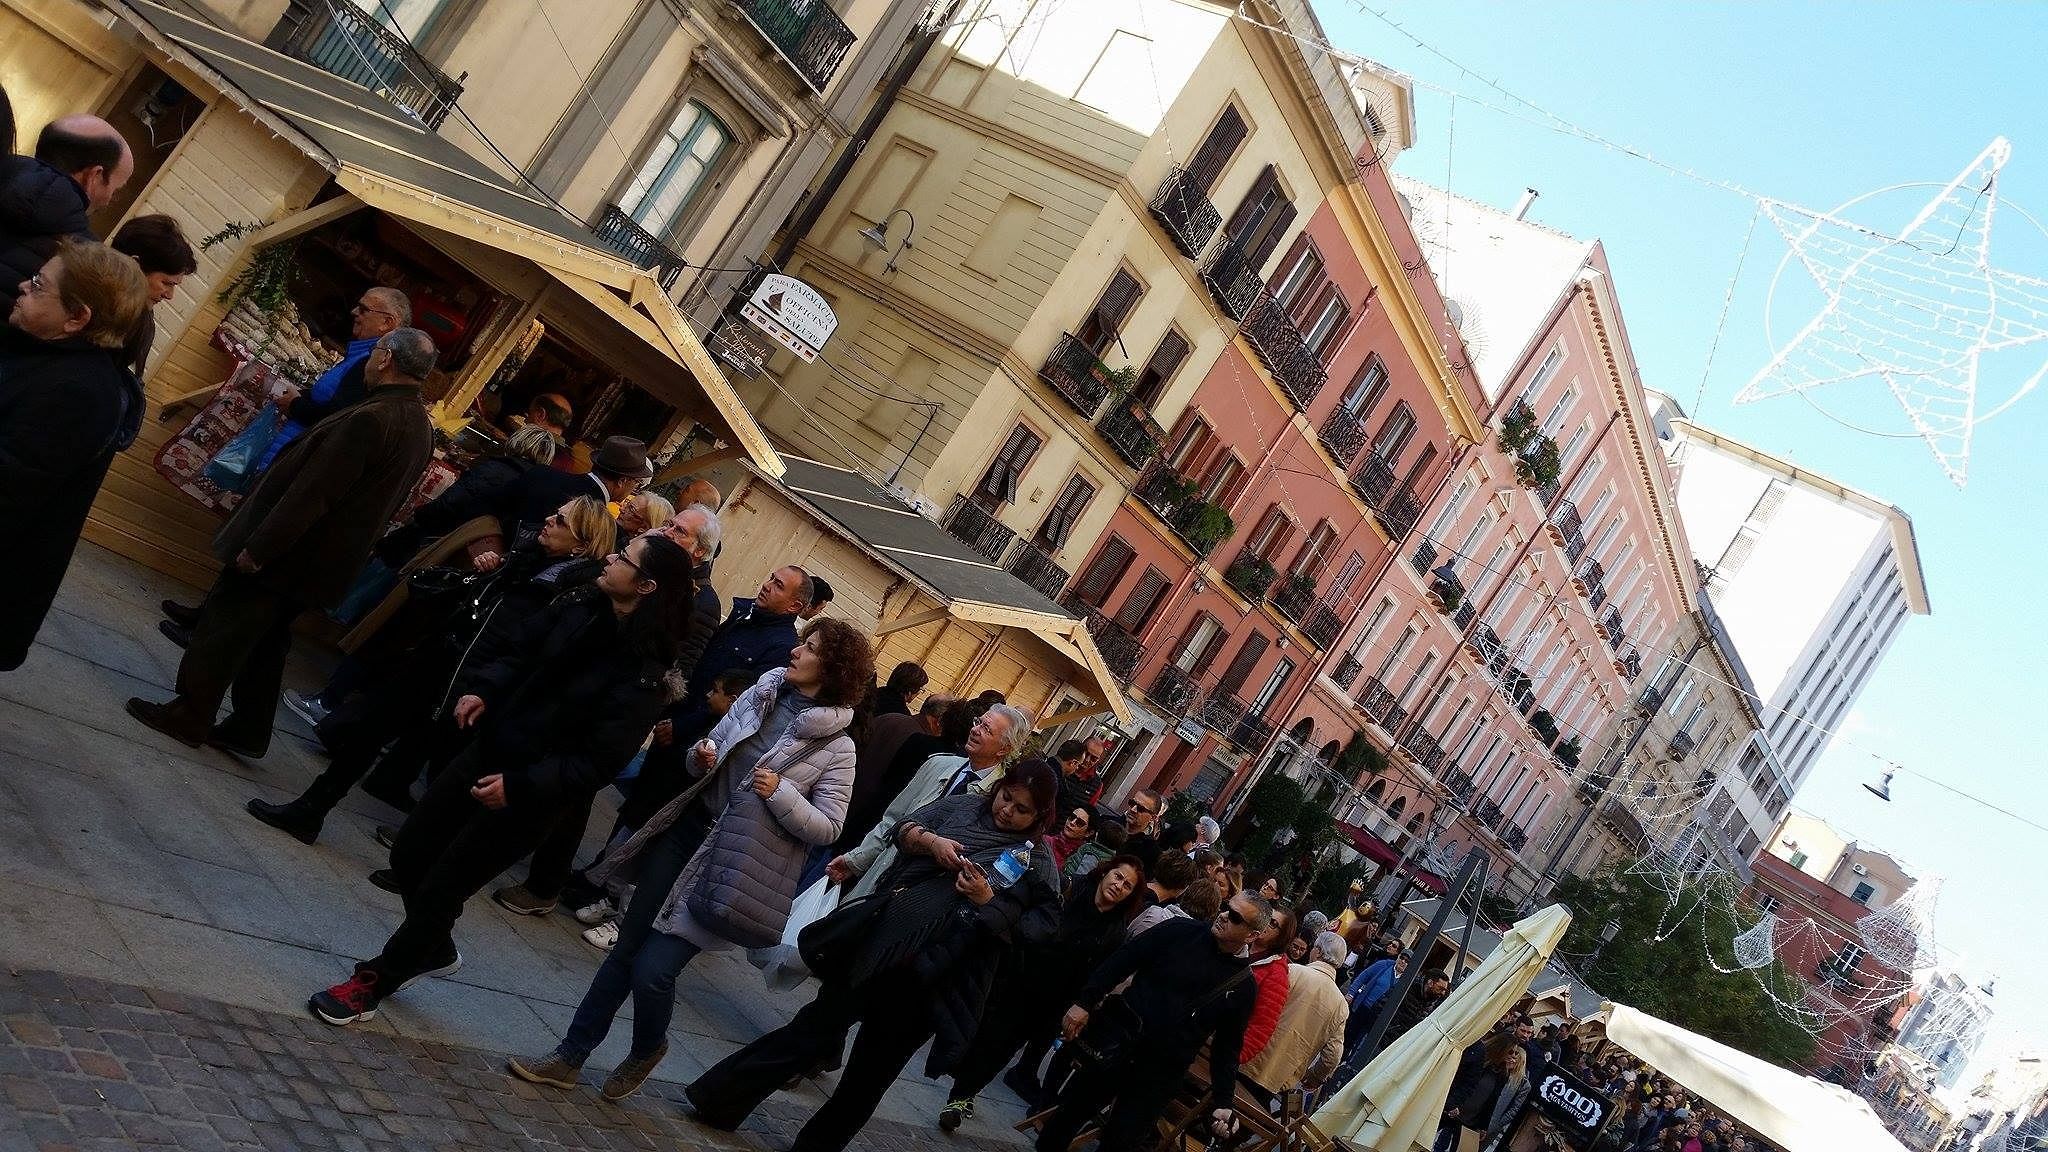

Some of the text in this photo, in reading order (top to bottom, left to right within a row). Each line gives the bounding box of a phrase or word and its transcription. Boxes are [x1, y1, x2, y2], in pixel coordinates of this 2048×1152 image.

[783, 316, 821, 344] SALUTE
[786, 297, 830, 332] OFFICINA
[727, 322, 768, 358] Ristorante
[1413, 876, 1425, 888] PUB
